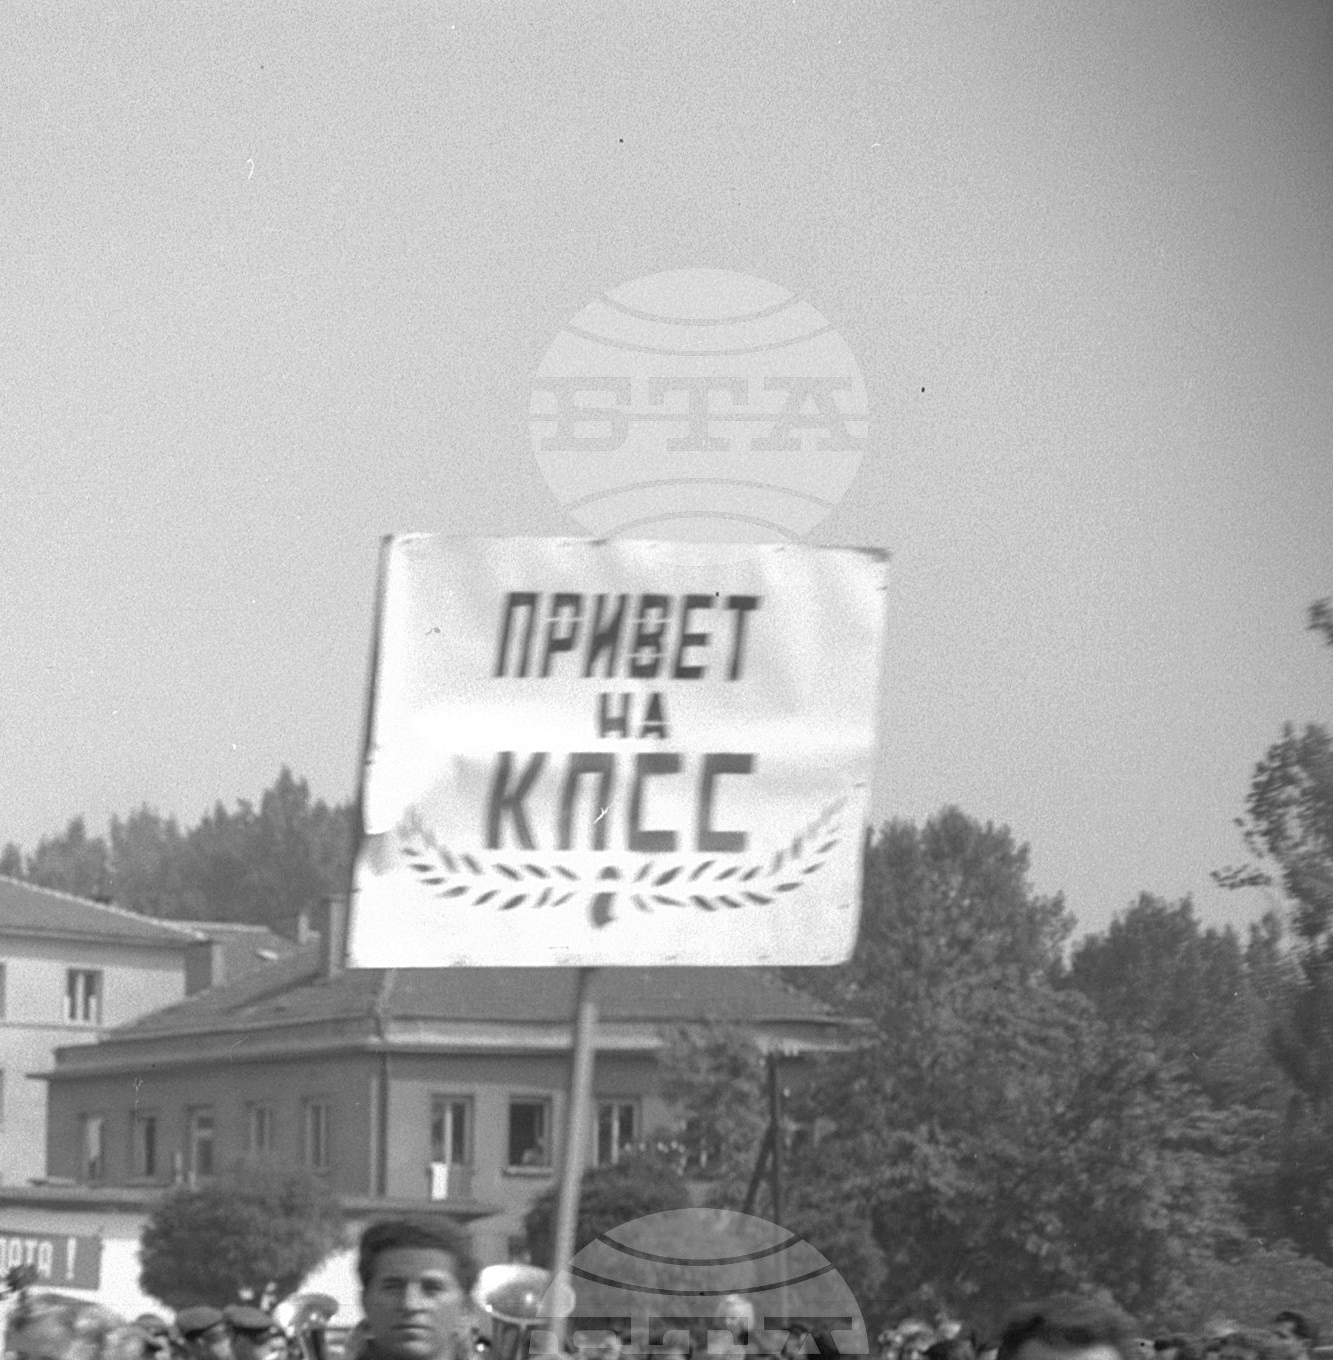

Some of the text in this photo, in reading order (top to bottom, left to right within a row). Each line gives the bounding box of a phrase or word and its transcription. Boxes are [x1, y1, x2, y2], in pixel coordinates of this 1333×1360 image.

[493, 590, 764, 682] ПРИВЕТ
[596, 692, 671, 739] НА
[483, 750, 757, 853] КПСС
